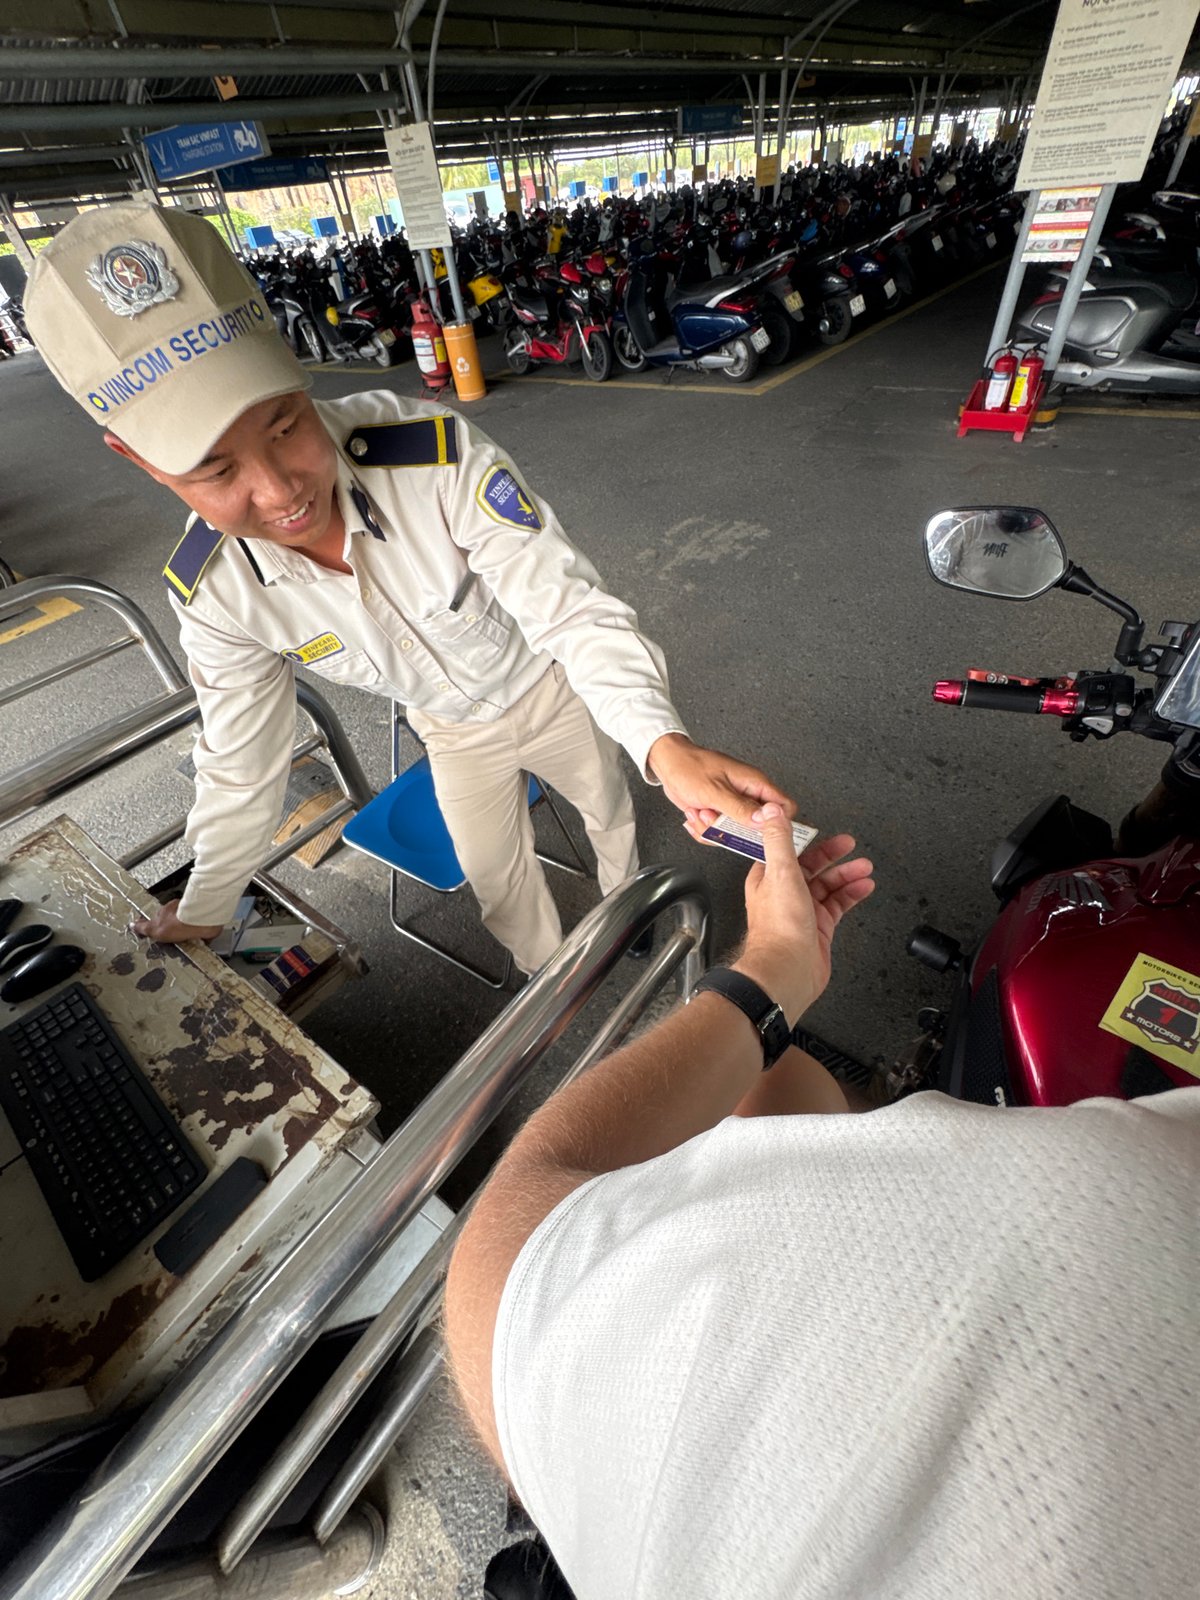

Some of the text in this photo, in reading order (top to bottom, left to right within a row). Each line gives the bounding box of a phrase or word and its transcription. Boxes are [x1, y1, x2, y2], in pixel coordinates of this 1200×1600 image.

[199, 128, 220, 142] VINFAST
[181, 142, 224, 161] CHARGING STATION
[99, 306, 254, 406] VINCOM SECURITY
[303, 635, 337, 654] VINPEARL
[308, 642, 338, 659] SECURITY
[1142, 960, 1187, 983] MOTORBIKES
[1159, 1006, 1179, 1026] 1
[1136, 1016, 1182, 1043] MOTORS
